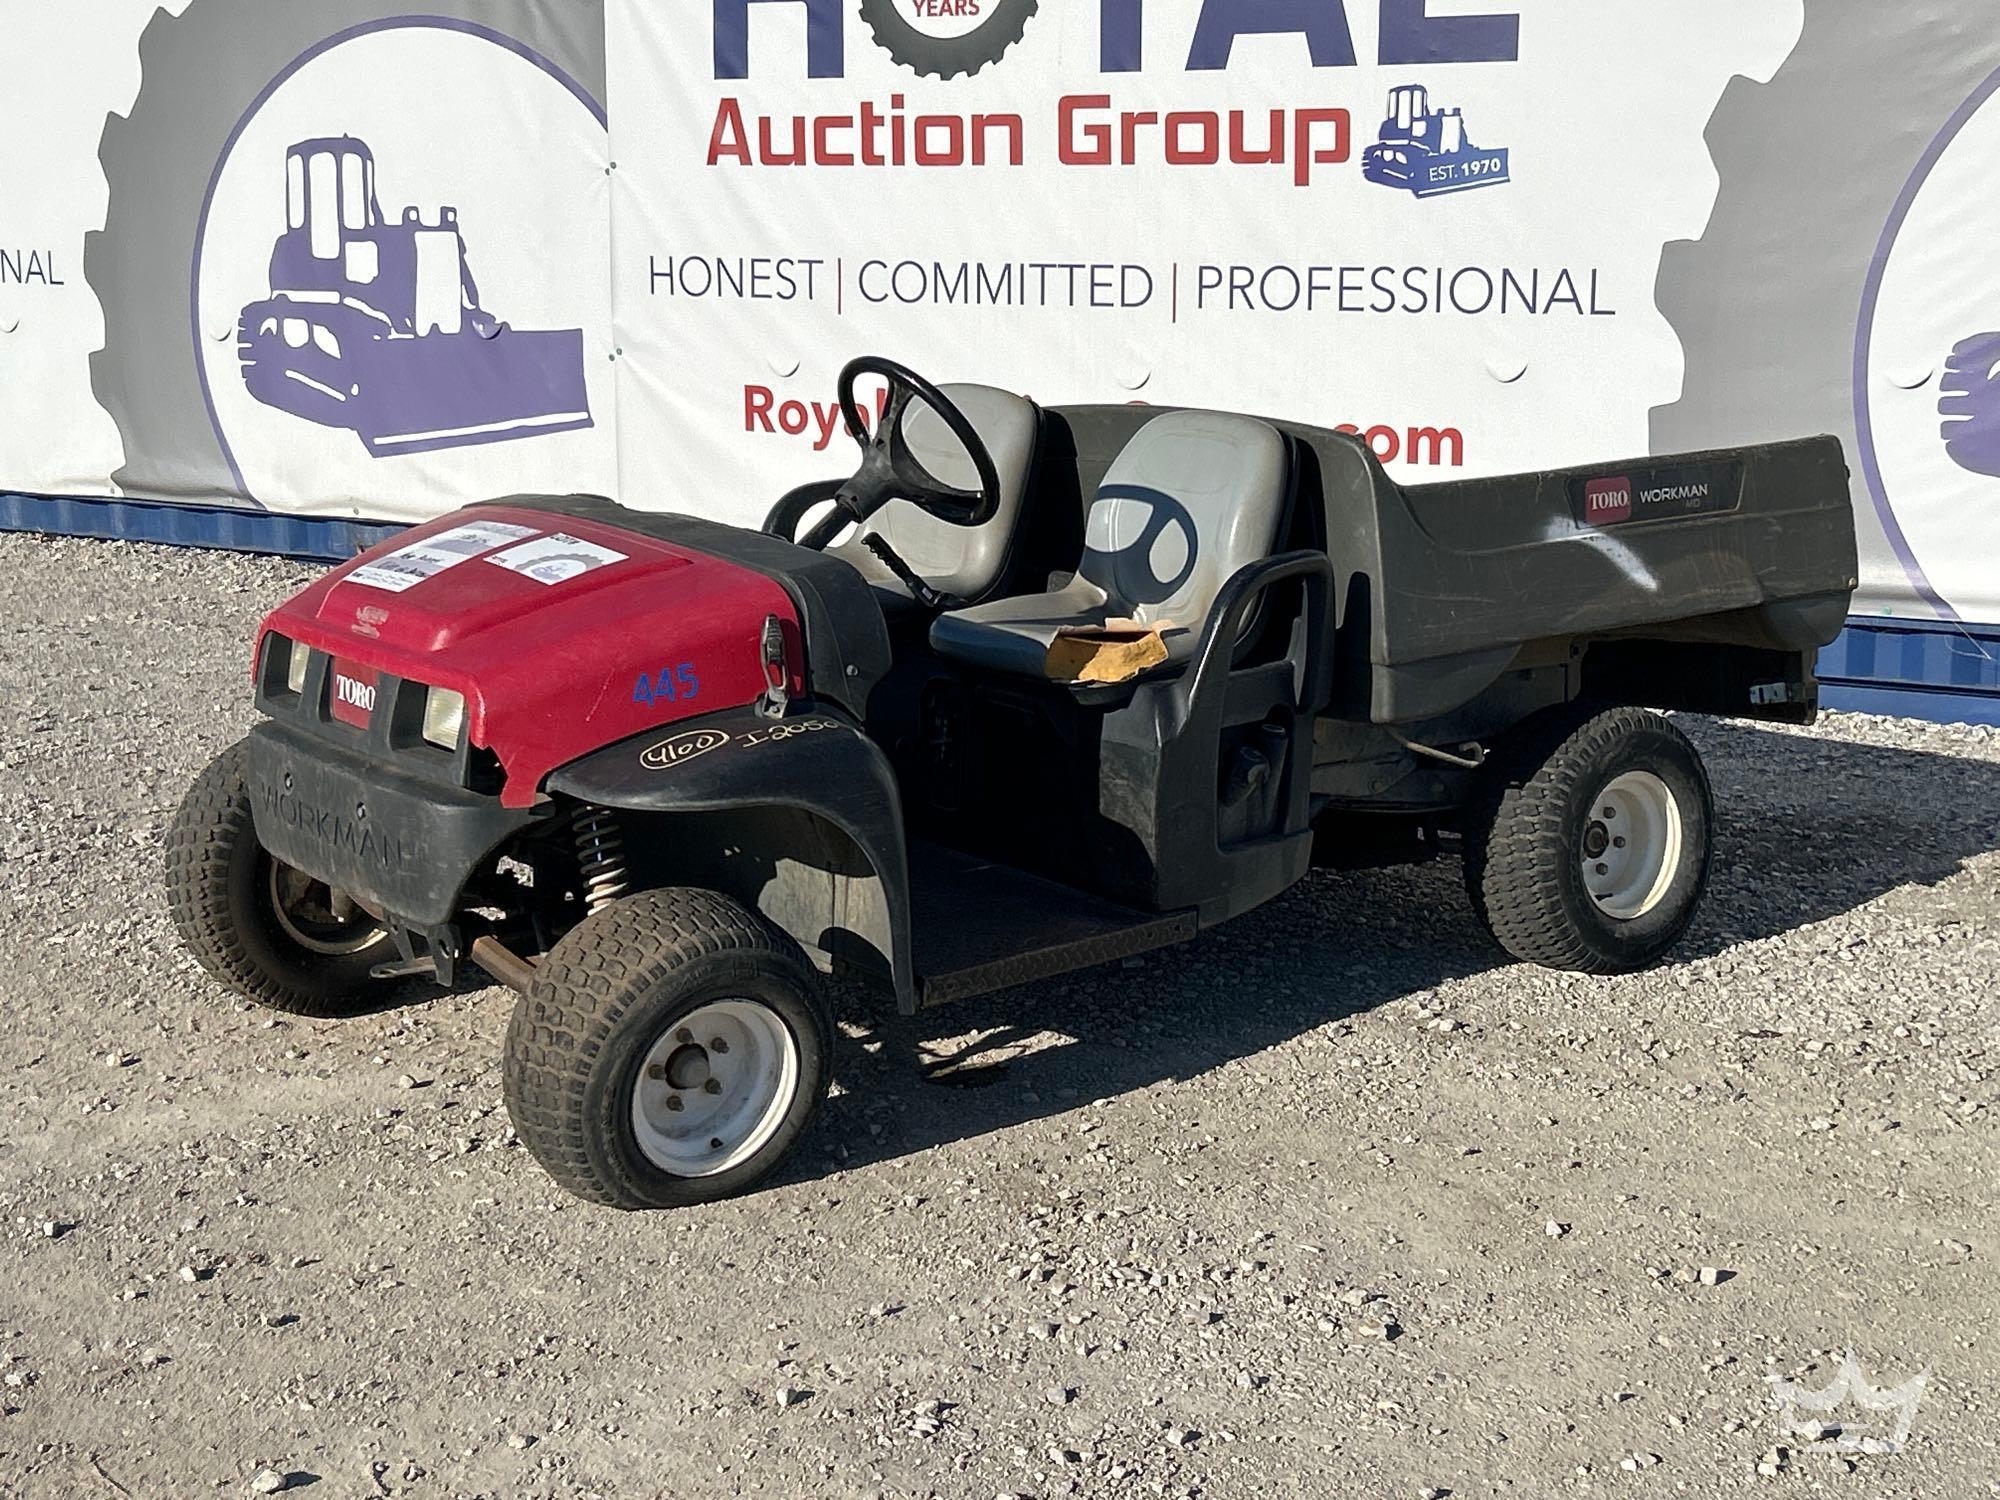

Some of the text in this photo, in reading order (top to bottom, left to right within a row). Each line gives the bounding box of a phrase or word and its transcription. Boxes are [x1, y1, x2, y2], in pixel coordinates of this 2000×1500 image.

[912, 0, 981, 17] YEARS
[707, 94, 1351, 186] Auction Group
[1428, 158, 1502, 182] EST. 1970
[650, 255, 1616, 316] HONEST COMMITTED PROFESSIONAL
[1334, 423, 1464, 467] om
[1588, 484, 1709, 510] TORO WORKMAN
[336, 674, 376, 712] TORO
[633, 662, 700, 706] 445
[261, 781, 403, 867] WORKMAN
